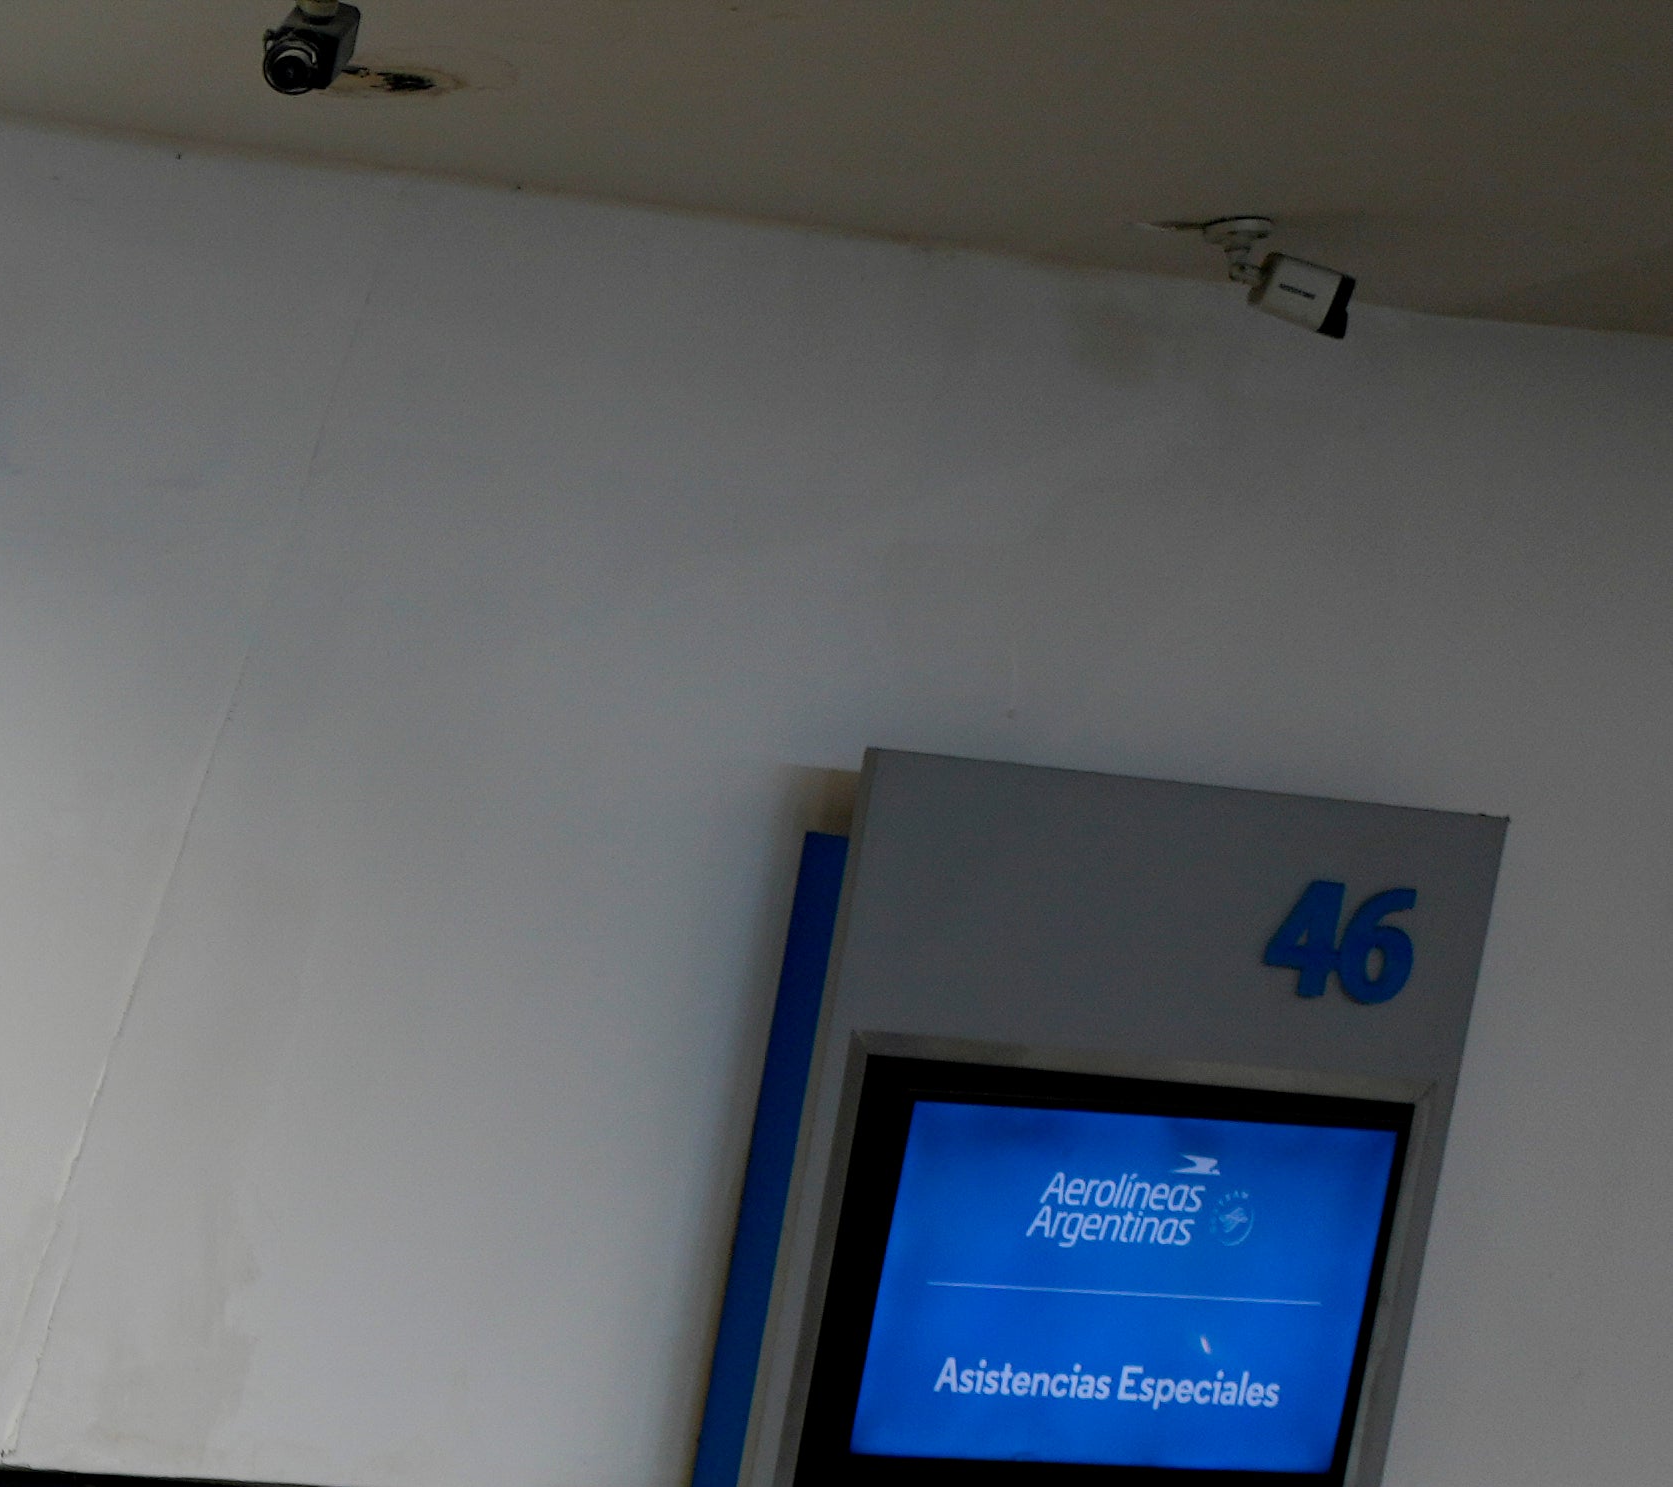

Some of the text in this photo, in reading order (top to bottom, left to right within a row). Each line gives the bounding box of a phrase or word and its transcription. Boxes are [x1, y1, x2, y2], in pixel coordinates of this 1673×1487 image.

[1264, 879, 1419, 1005] 46
[1040, 1171, 1206, 1213] Aerolíneas
[1026, 1205, 1195, 1248] Argentinas
[934, 1355, 1281, 1411] Asistencias Especiales
